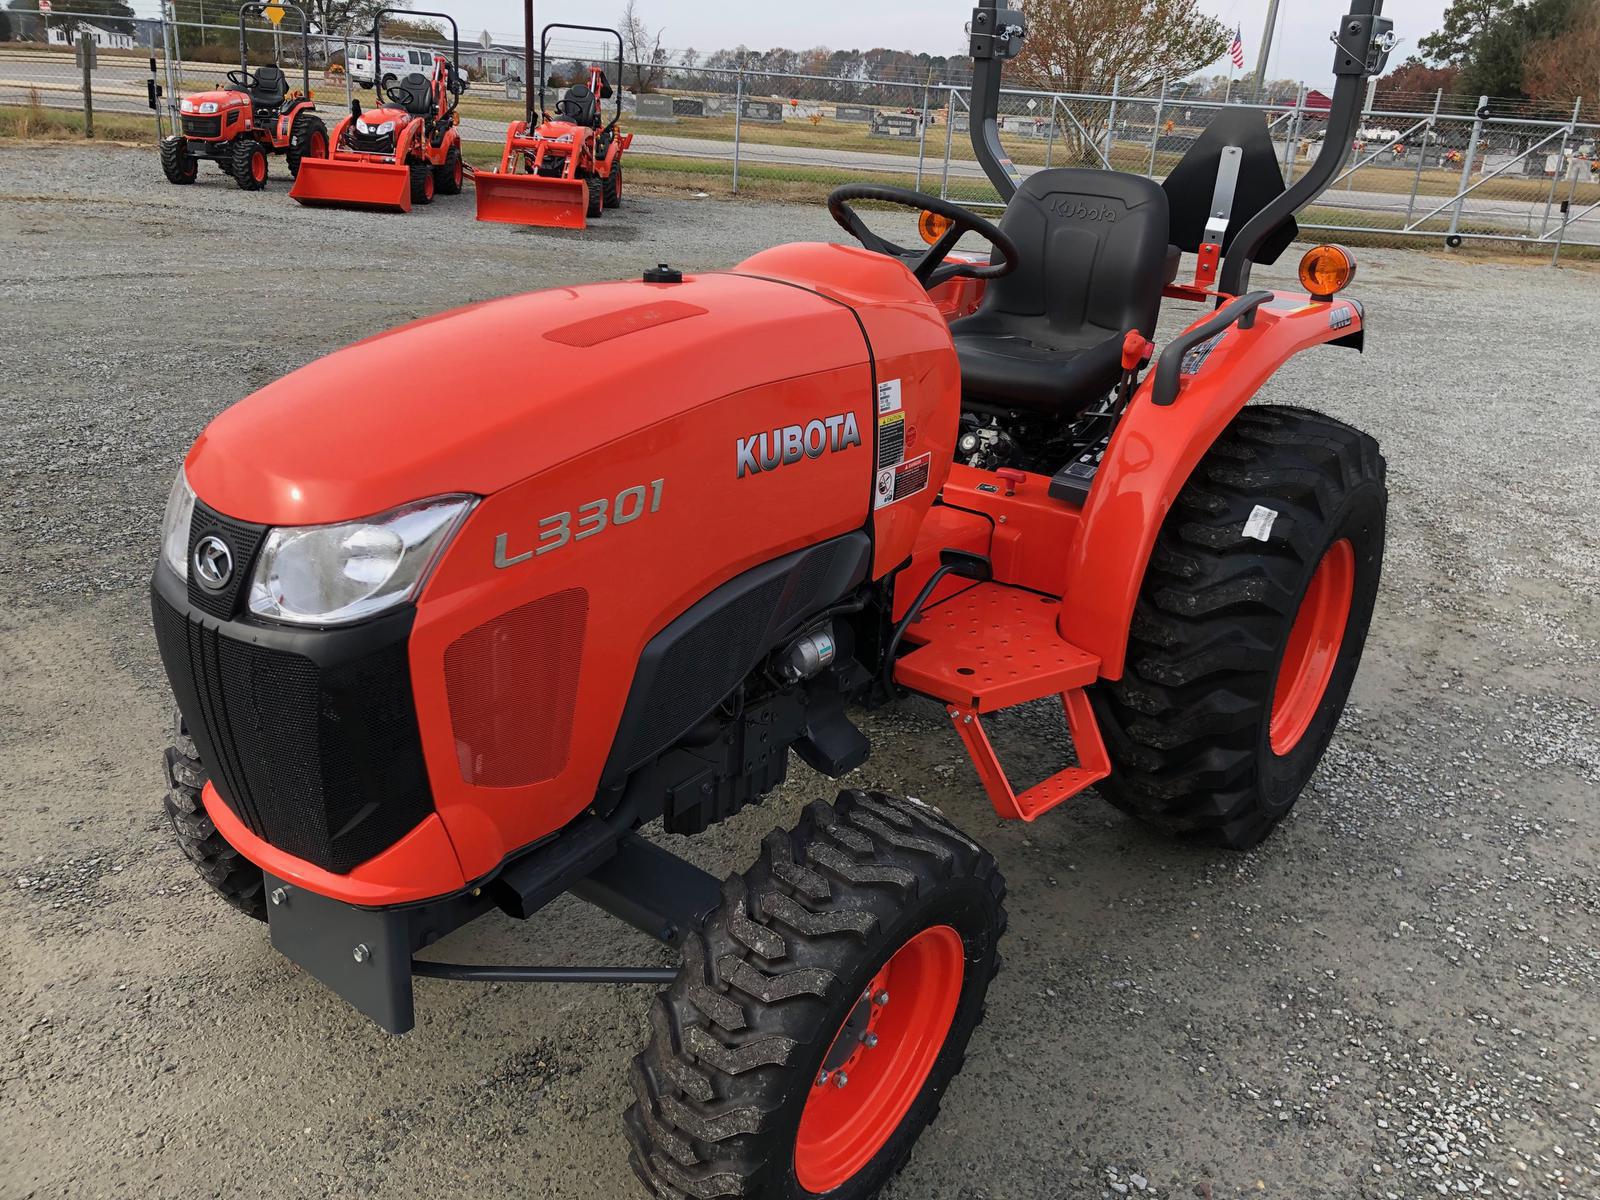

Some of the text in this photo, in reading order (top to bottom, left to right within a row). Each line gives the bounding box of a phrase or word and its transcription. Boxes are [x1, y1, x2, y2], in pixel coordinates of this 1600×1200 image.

[1049, 199, 1117, 224] Kubota
[736, 411, 862, 479] KUBOTA
[494, 478, 664, 569] L3301
